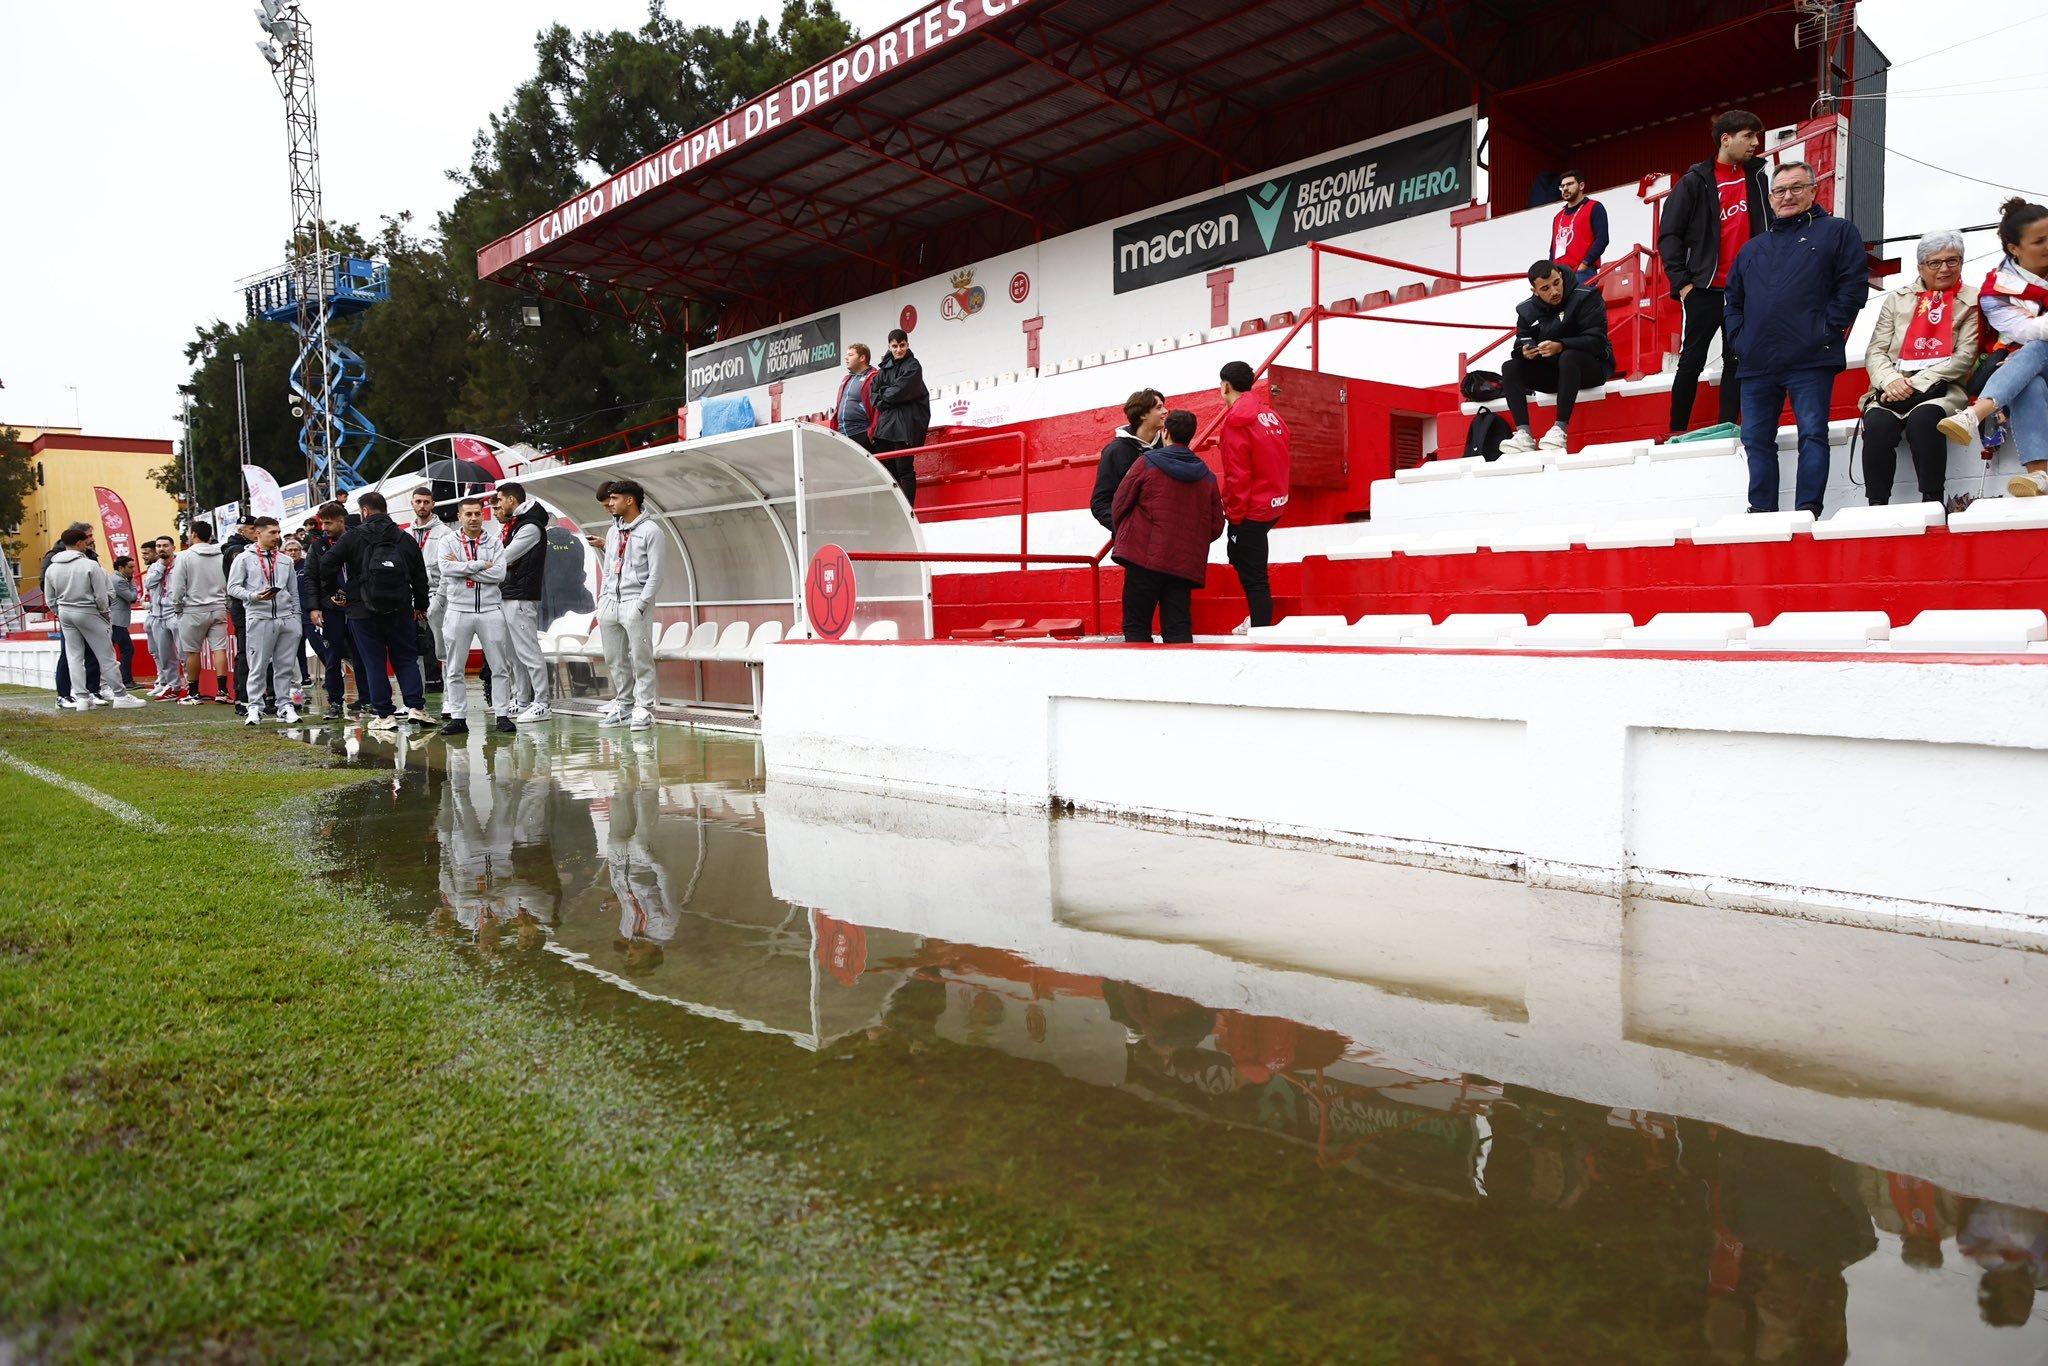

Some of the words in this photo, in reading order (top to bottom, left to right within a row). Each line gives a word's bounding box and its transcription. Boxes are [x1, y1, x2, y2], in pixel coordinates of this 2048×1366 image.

[540, 188, 605, 245] CAMPO
[611, 119, 737, 210] MUNICIPAL
[745, 92, 781, 140] DE
[792, 0, 967, 117] DEPORTES
[1292, 198, 1342, 234] YOUR
[1345, 182, 1395, 219] OWN
[1398, 166, 1460, 205] HERO.
[1296, 162, 1378, 208] BECOME
[1121, 213, 1239, 273] macron
[766, 353, 789, 374] YOUR
[789, 348, 811, 368] OWN
[811, 341, 837, 362] HERO.
[768, 333, 803, 357] BECOME
[691, 355, 744, 388] macron
